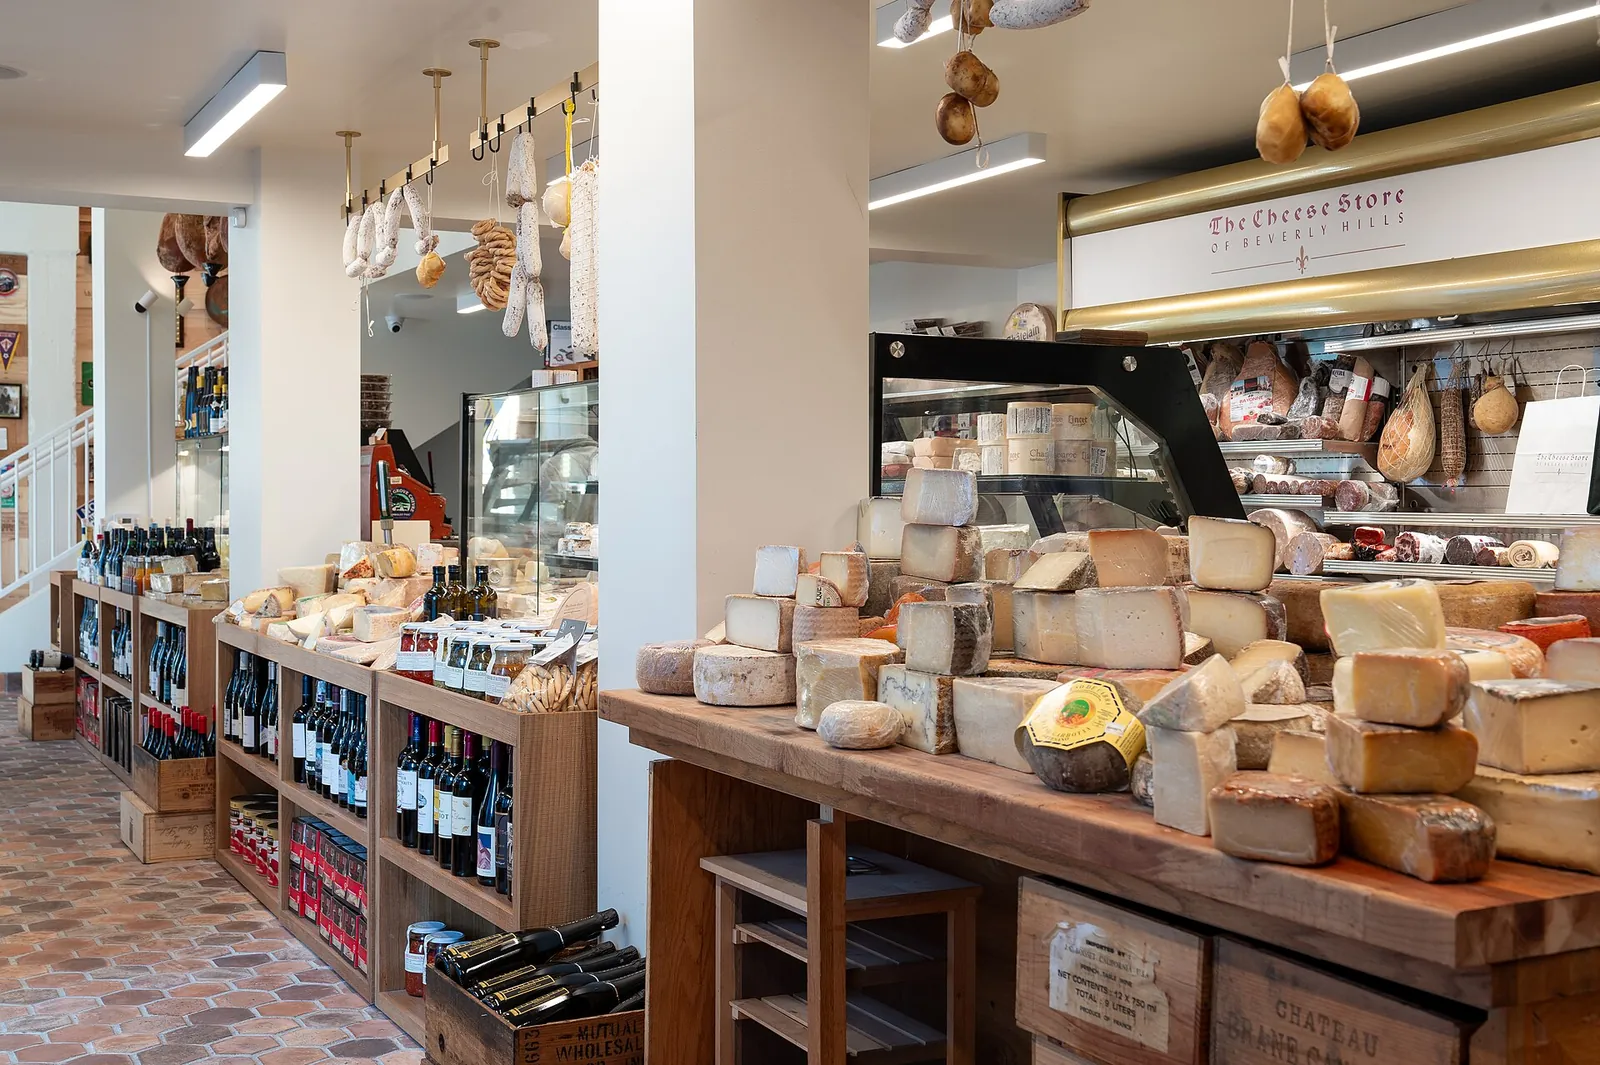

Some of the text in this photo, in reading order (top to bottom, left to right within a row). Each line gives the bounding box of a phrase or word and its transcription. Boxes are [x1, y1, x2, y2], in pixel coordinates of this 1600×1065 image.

[1209, 188, 1404, 236] The Cheese Store
[1211, 212, 1404, 253] OF BEVERLY HILLS
[1548, 453, 1570, 461] Cheese
[1570, 453, 1588, 461] Store
[1057, 969, 1071, 980] NET
[1072, 975, 1108, 994] CONTENTS
[1114, 991, 1123, 1000] 12
[1132, 997, 1145, 1009] 750
[1146, 1003, 1157, 1013] ml
[1075, 988, 1097, 1003] TOTAL
[1104, 999, 1110, 1007] 9
[1112, 1002, 1136, 1018] LITERS
[577, 1020, 640, 1041] MUTUAL
[1275, 999, 1380, 1058] CHATEAU
